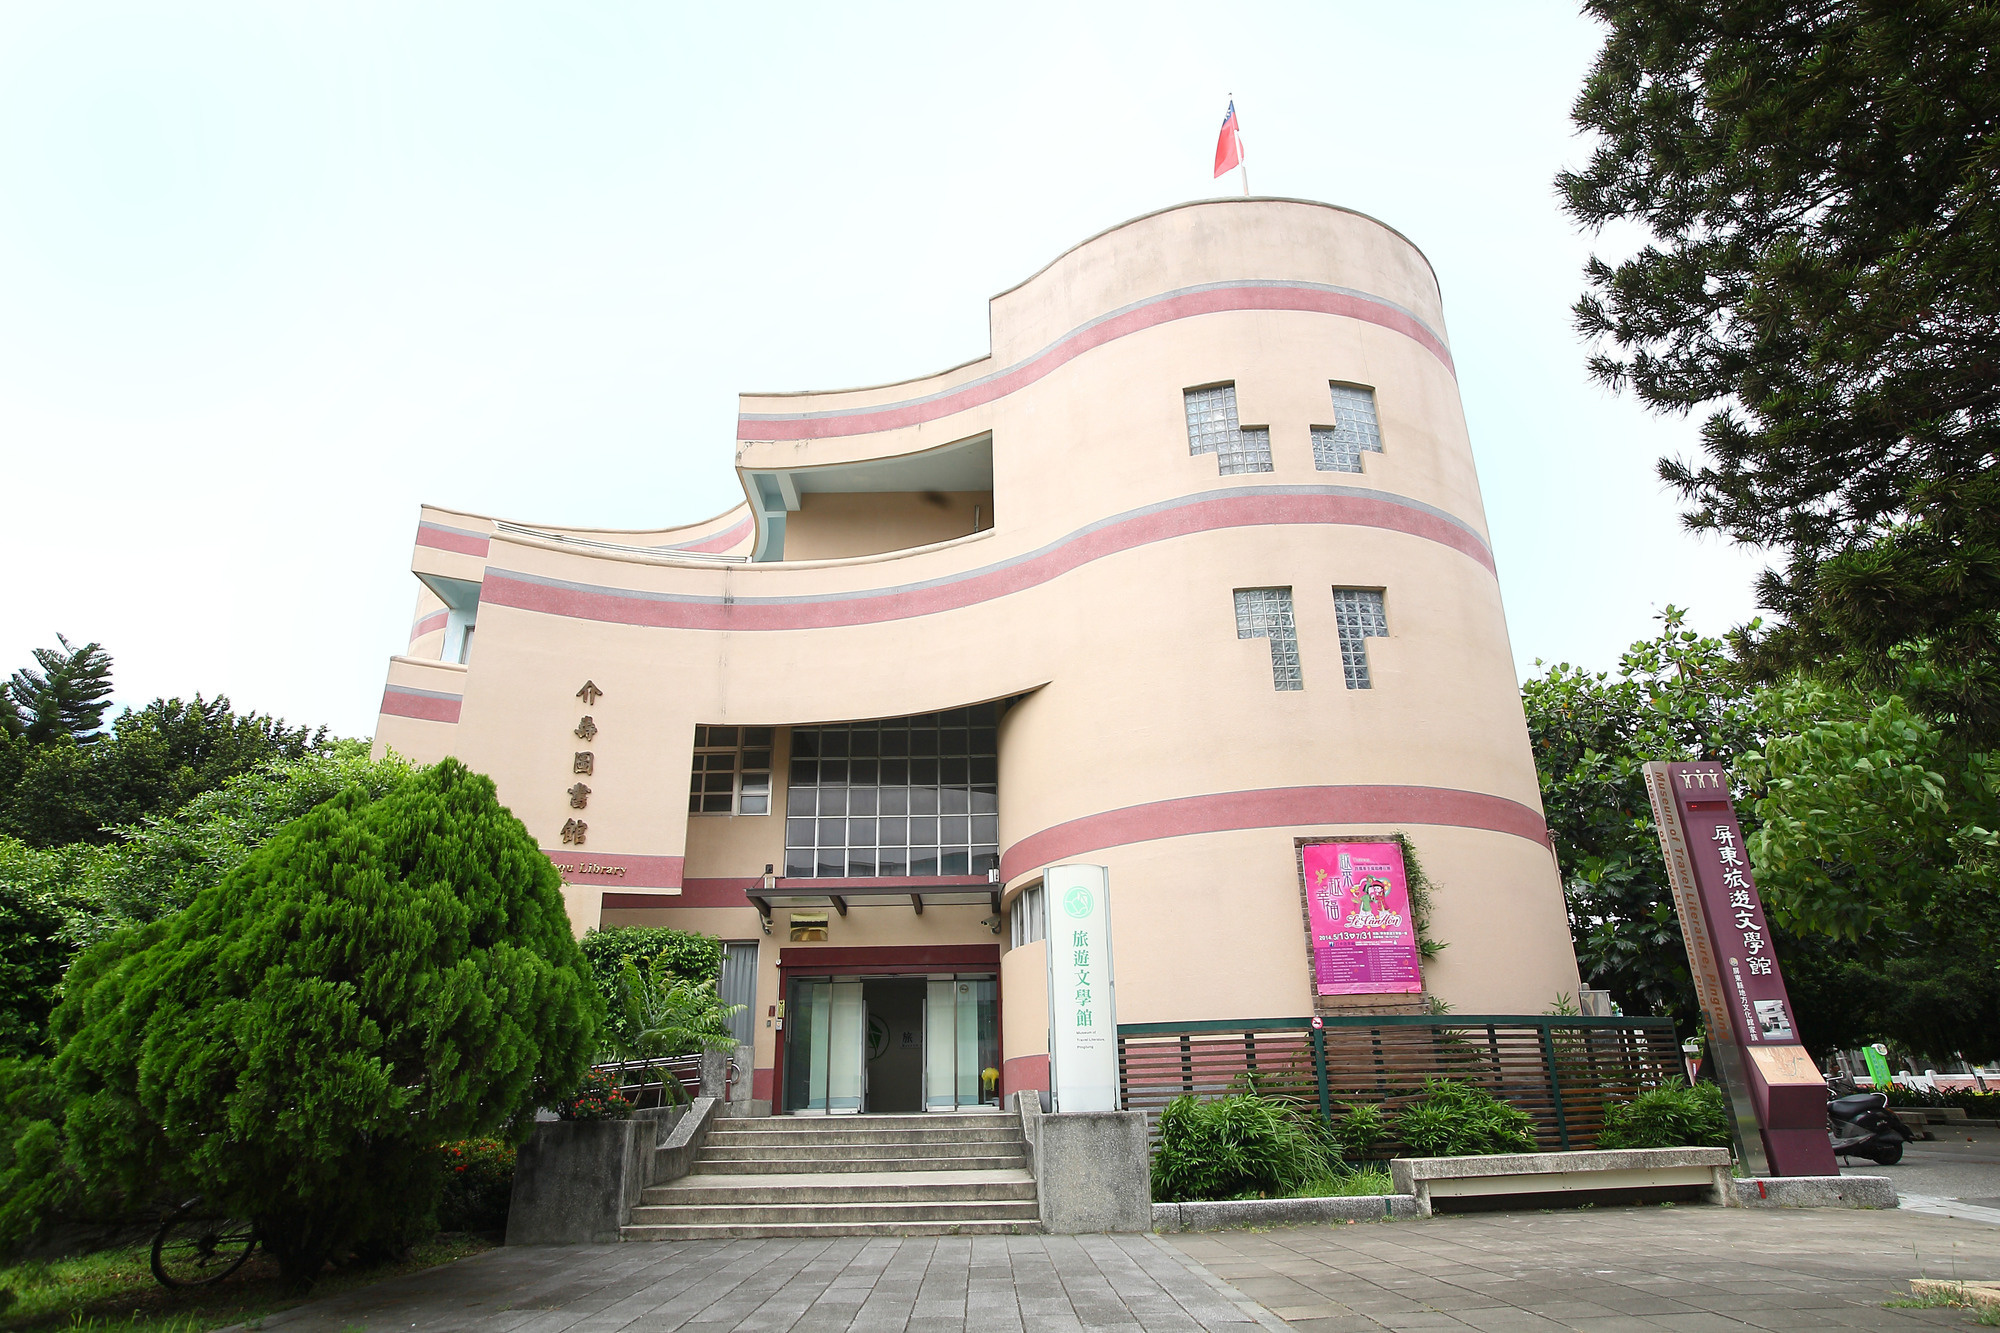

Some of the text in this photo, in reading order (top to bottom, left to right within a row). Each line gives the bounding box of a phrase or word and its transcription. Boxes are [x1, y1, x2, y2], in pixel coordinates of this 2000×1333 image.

[560, 679, 603, 845] 介壽圖書館
[578, 862, 627, 877] Library
[1645, 774, 1661, 827] Museum
[1659, 830, 1667, 843] of
[1664, 848, 1679, 891] Travel
[1655, 771, 1729, 1041] Museum of Travel Literature, Pingtung
[1711, 825, 1772, 976] 屏東旅遊文學館
[1072, 930, 1092, 1027] 旅遊文學館
